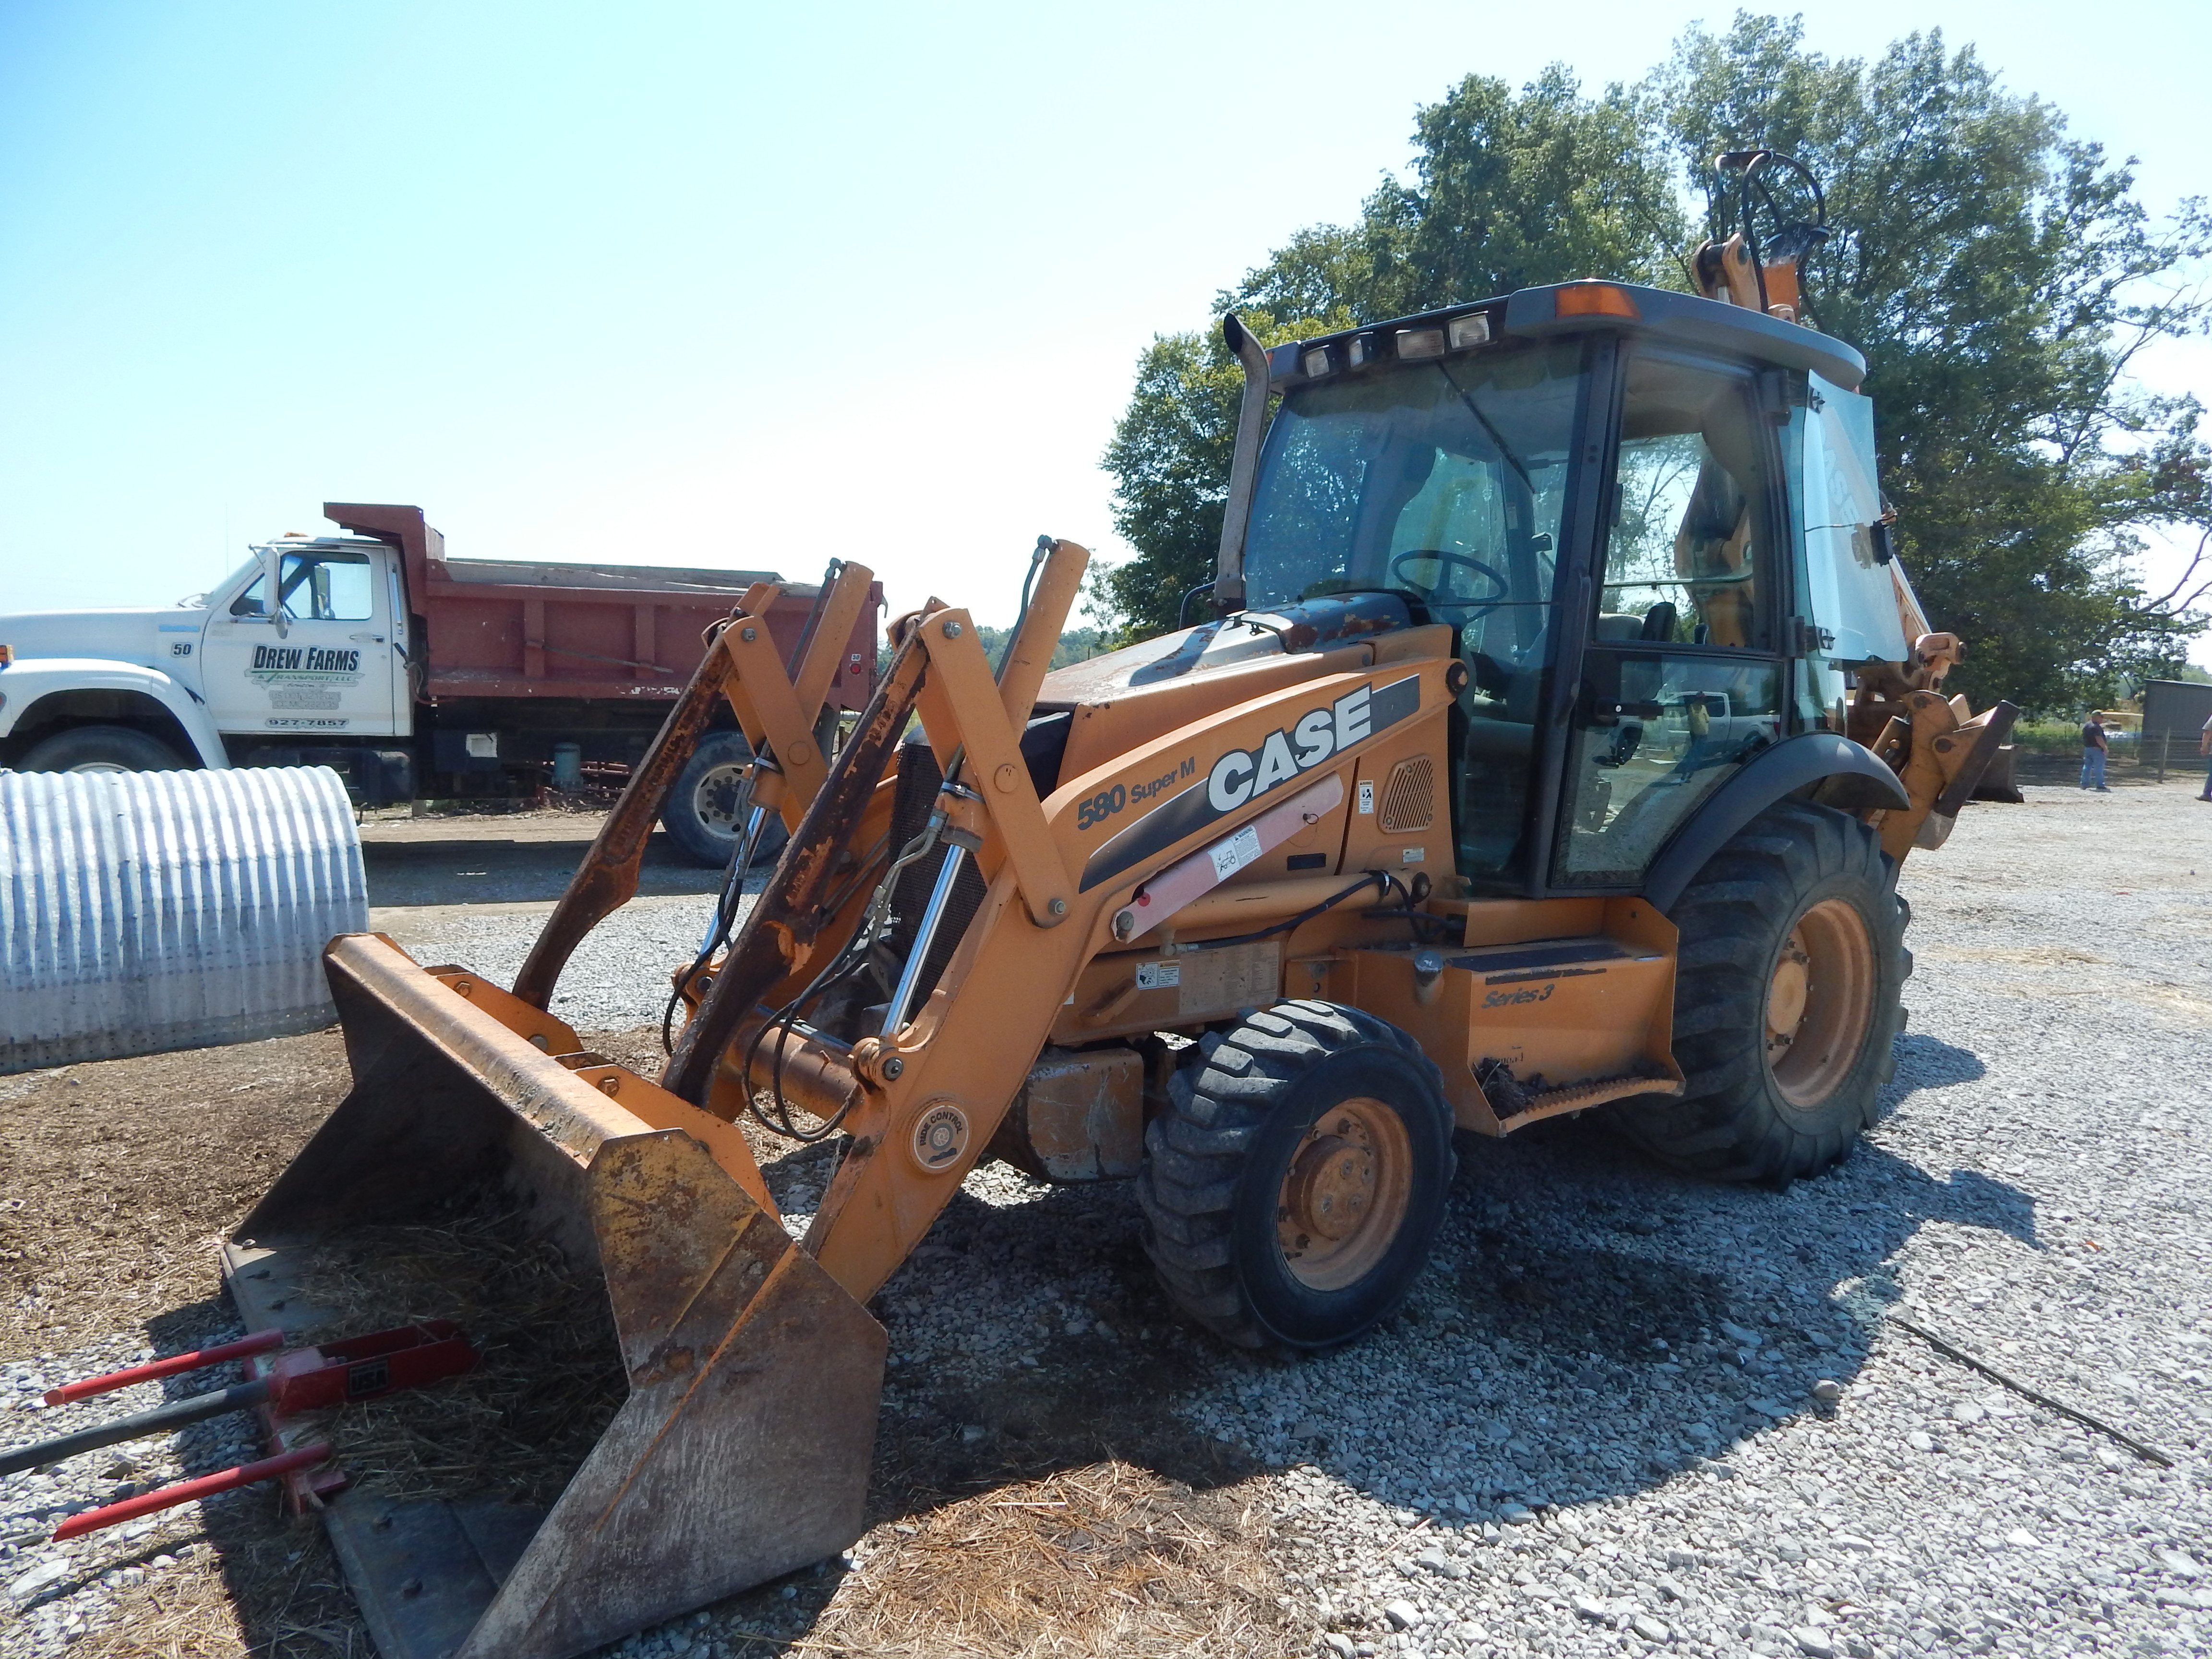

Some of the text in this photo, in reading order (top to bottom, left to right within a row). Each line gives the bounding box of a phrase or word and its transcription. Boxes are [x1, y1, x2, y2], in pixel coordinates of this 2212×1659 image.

[173, 644, 192, 655] 50
[253, 645, 359, 671] DREW FARMS
[1207, 684, 1372, 812] CASE
[1077, 756, 1195, 830] 580 Super M
[1481, 984, 1555, 1009] Series 3
[920, 1111, 963, 1146] RIDE CONTROL
